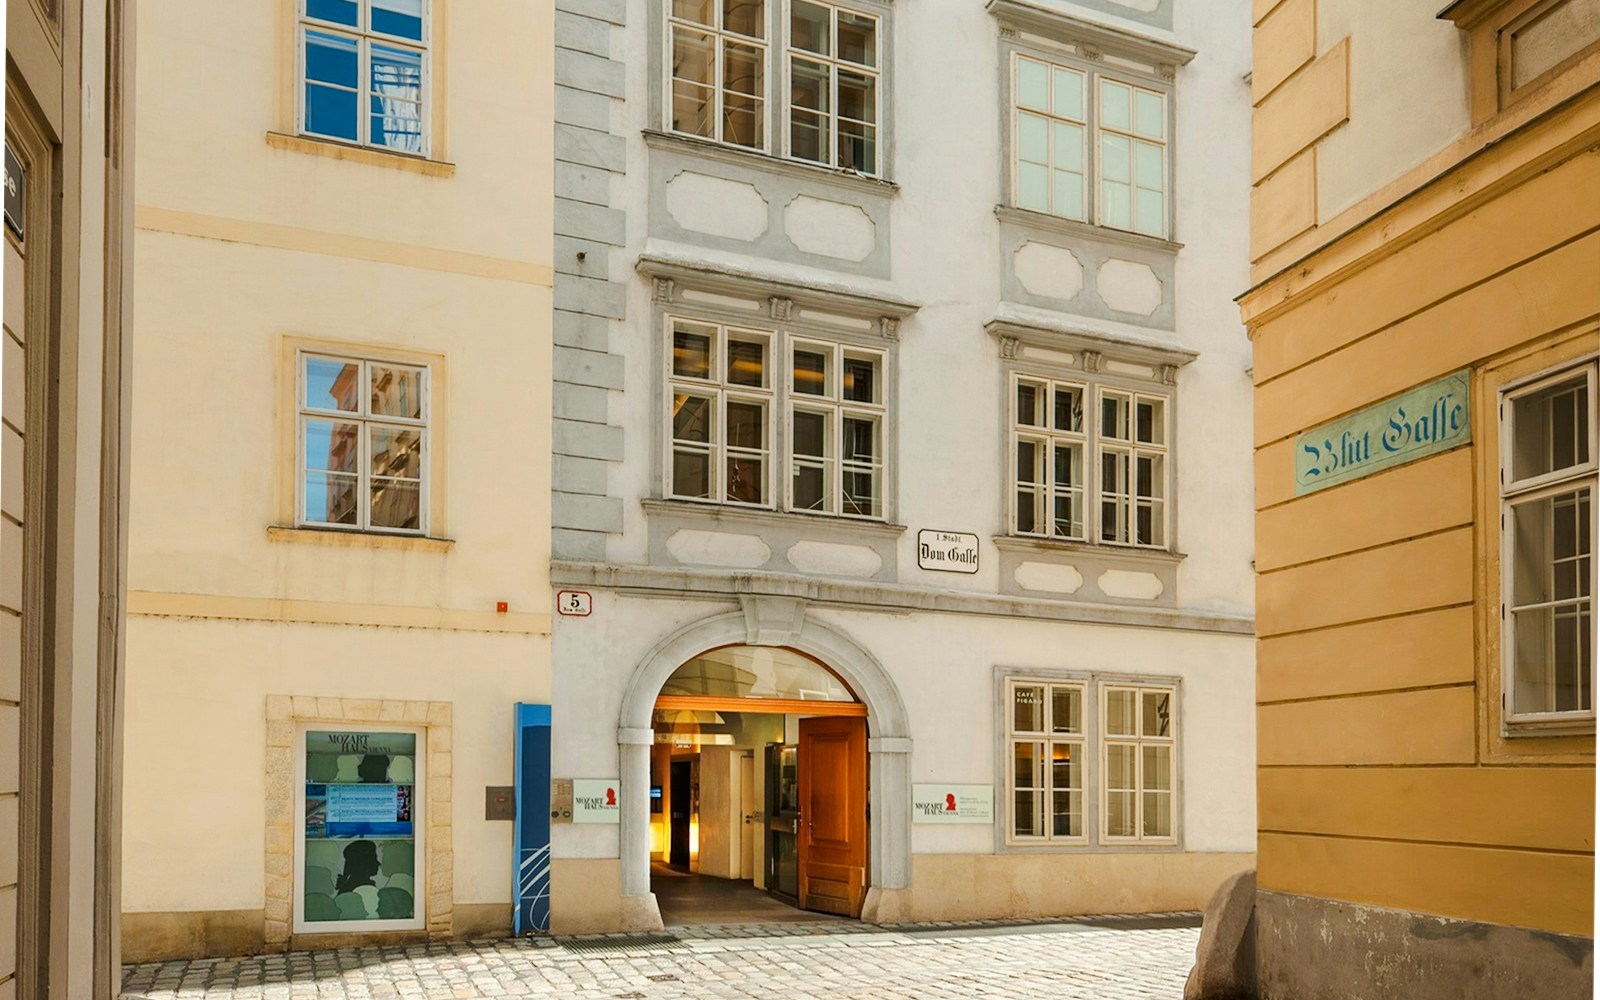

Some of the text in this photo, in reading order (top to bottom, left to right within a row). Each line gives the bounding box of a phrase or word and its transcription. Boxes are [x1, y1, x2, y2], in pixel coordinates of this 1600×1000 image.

[1304, 393, 1462, 478] Blut Gasse
[921, 543, 977, 564] Dom Gasse
[571, 594, 580, 607] 5
[328, 734, 369, 745] MOZART
[341, 743, 368, 753] HAUS
[576, 797, 603, 805] MOZART
